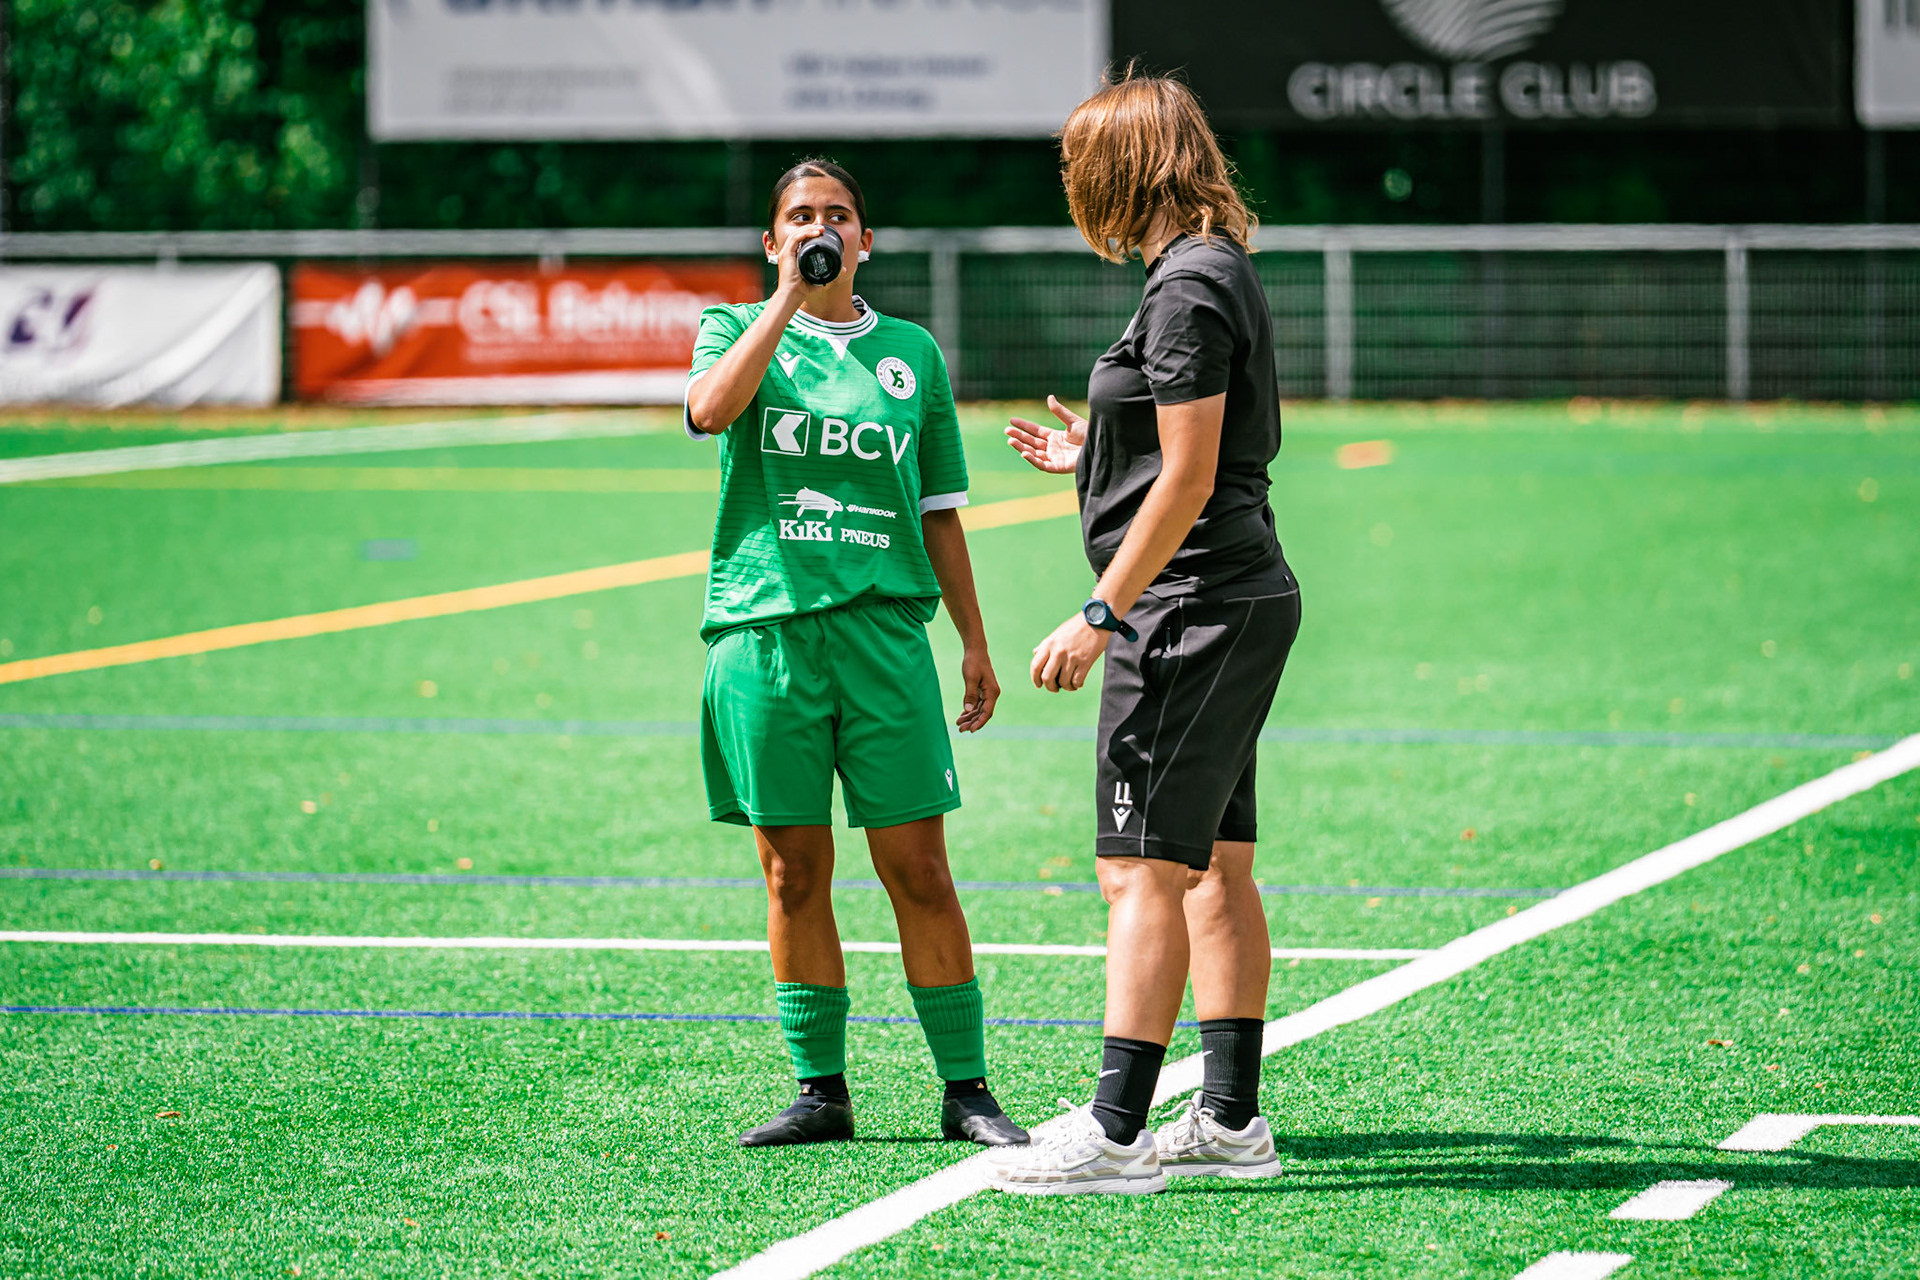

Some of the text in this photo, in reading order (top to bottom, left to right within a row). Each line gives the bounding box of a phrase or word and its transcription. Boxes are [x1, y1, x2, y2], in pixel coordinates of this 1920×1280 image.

[1288, 61, 1656, 118] CIRCLE CLUB
[819, 417, 911, 466] BCV
[840, 527, 890, 549] PNEUS
[1114, 781, 1133, 806] LL
